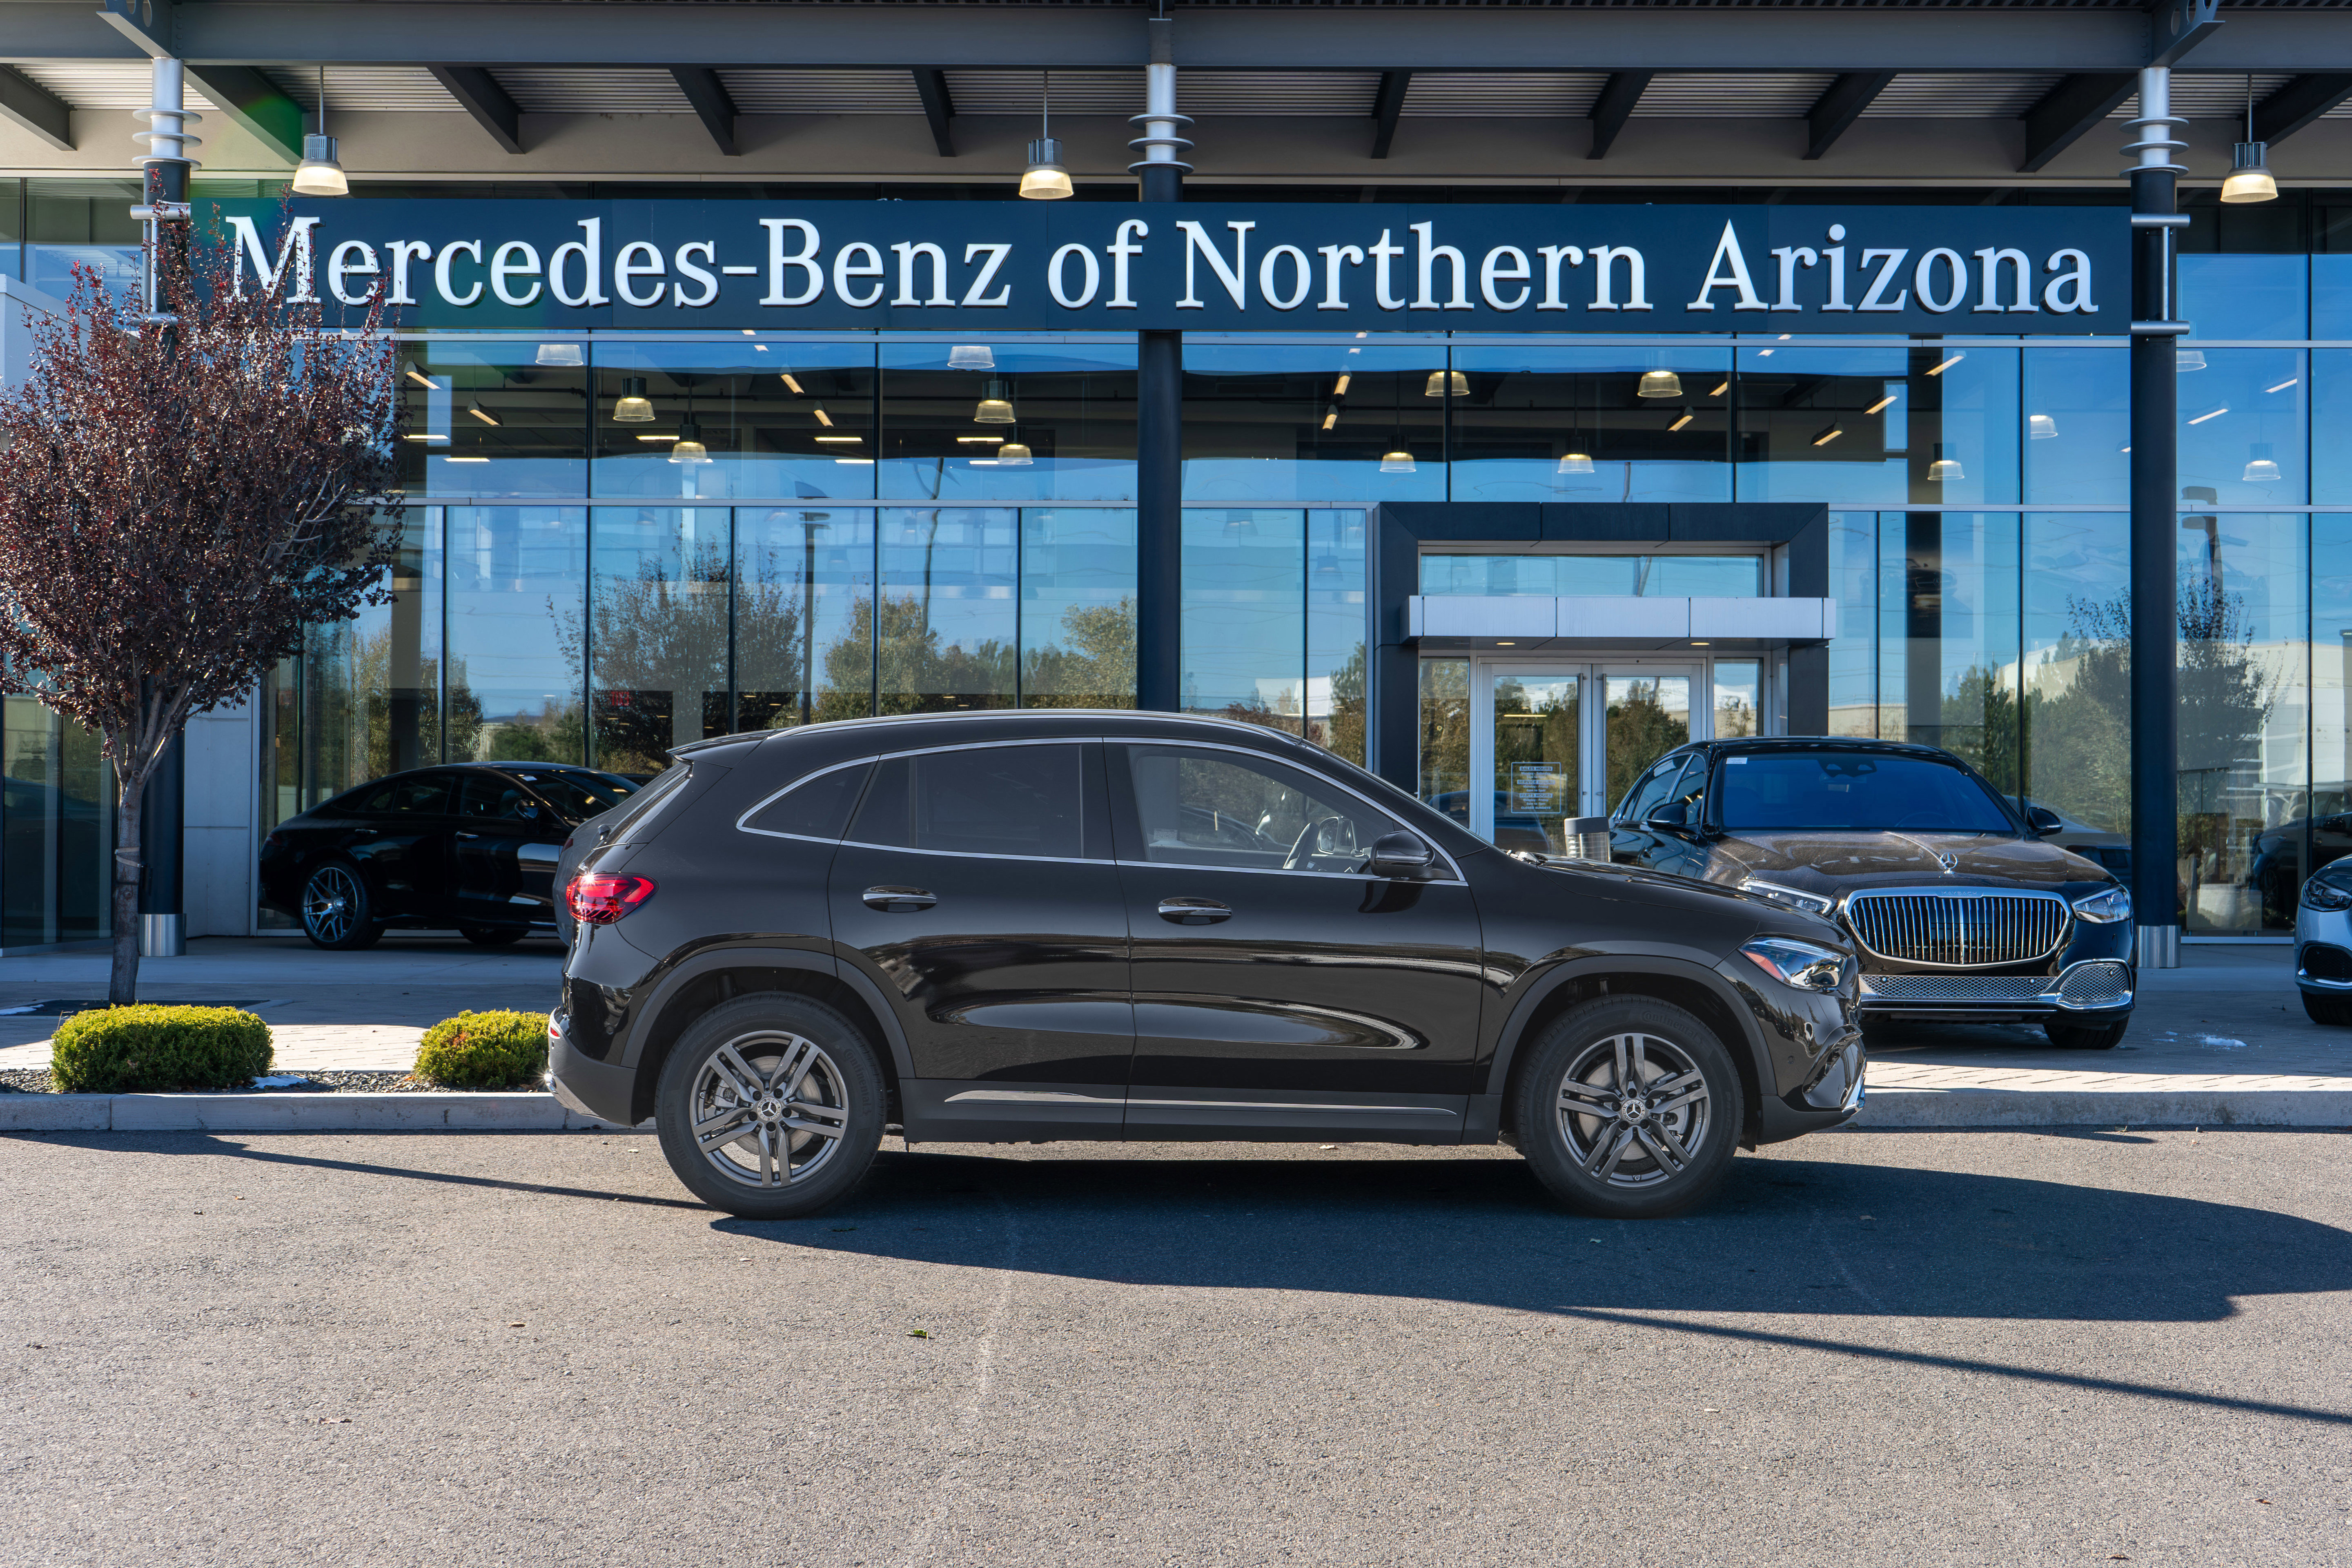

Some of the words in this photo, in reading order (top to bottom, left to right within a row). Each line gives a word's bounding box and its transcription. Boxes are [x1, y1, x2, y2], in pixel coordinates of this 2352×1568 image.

[225, 216, 1012, 307] Mercedes-Benz
[1048, 219, 1148, 307] of
[1176, 220, 1653, 310] Northern
[1687, 218, 2099, 312] Arizona
